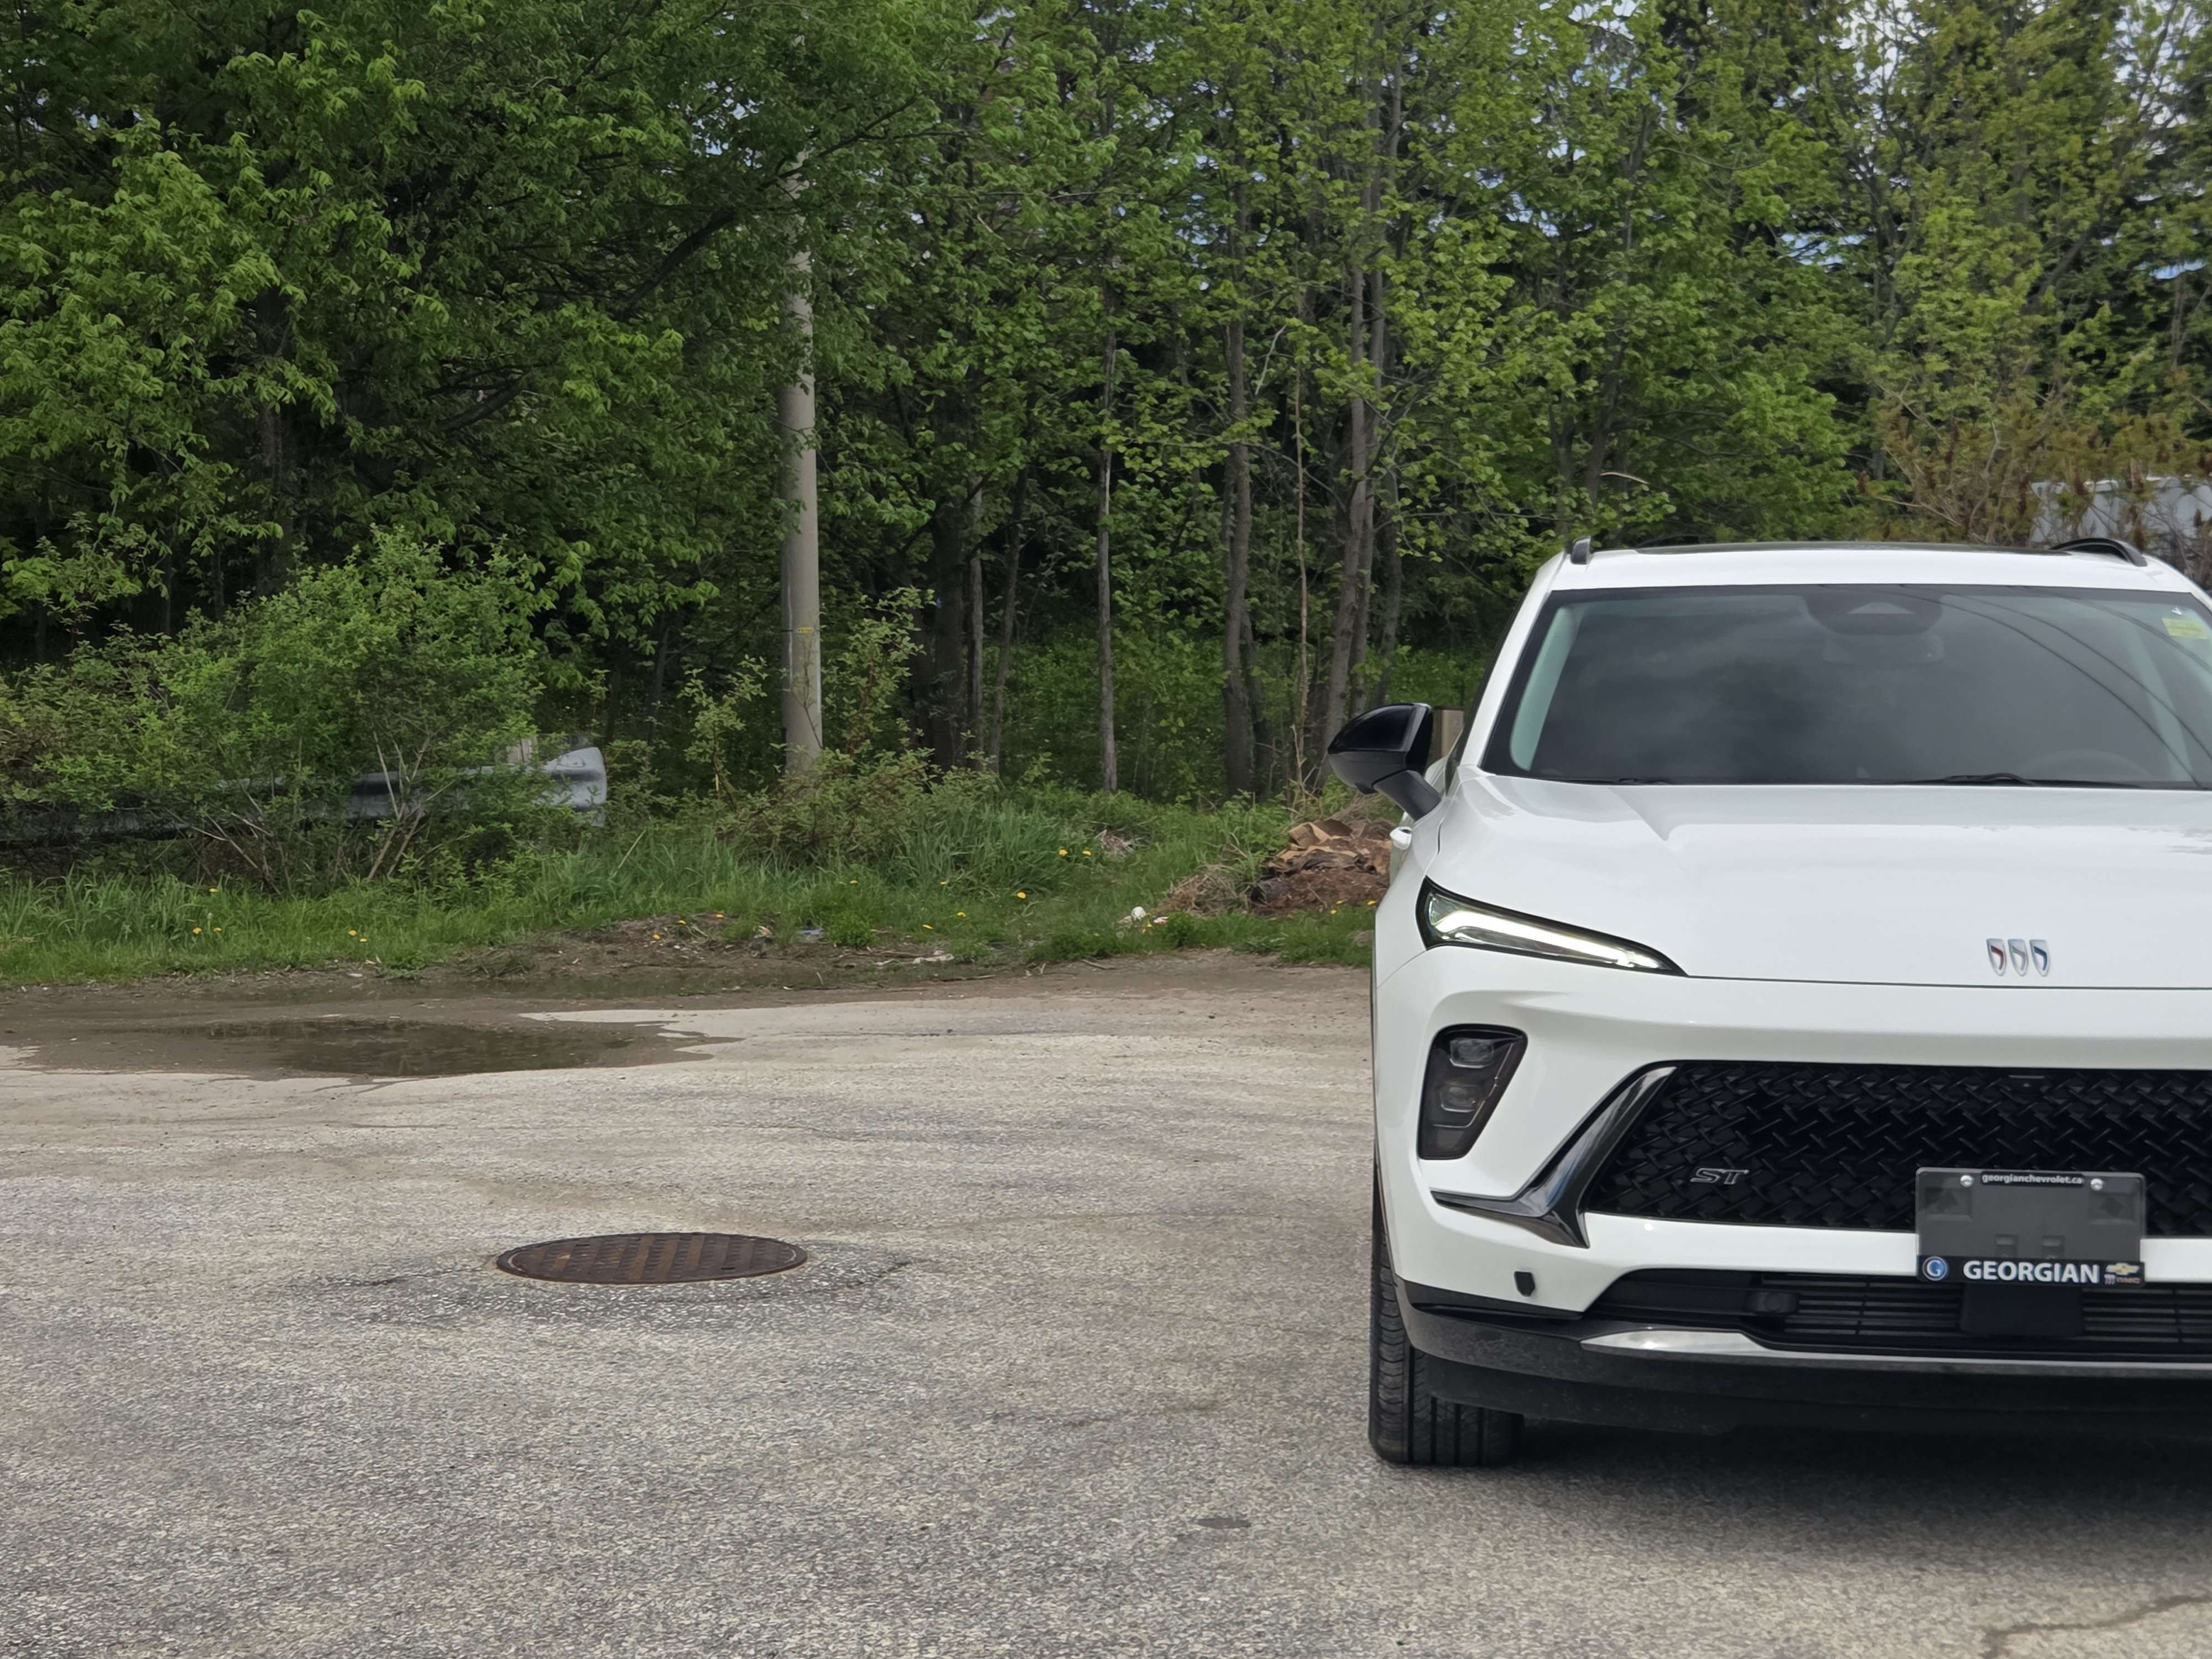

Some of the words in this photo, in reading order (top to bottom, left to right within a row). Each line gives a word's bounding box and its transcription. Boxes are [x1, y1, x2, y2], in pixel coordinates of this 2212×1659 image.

[1690, 1168, 1749, 1185] ST
[1981, 1173, 2083, 1185] georgianchevrolet.ca
[1927, 1259, 1942, 1277] G
[1963, 1260, 2099, 1284] GEORGIAN
